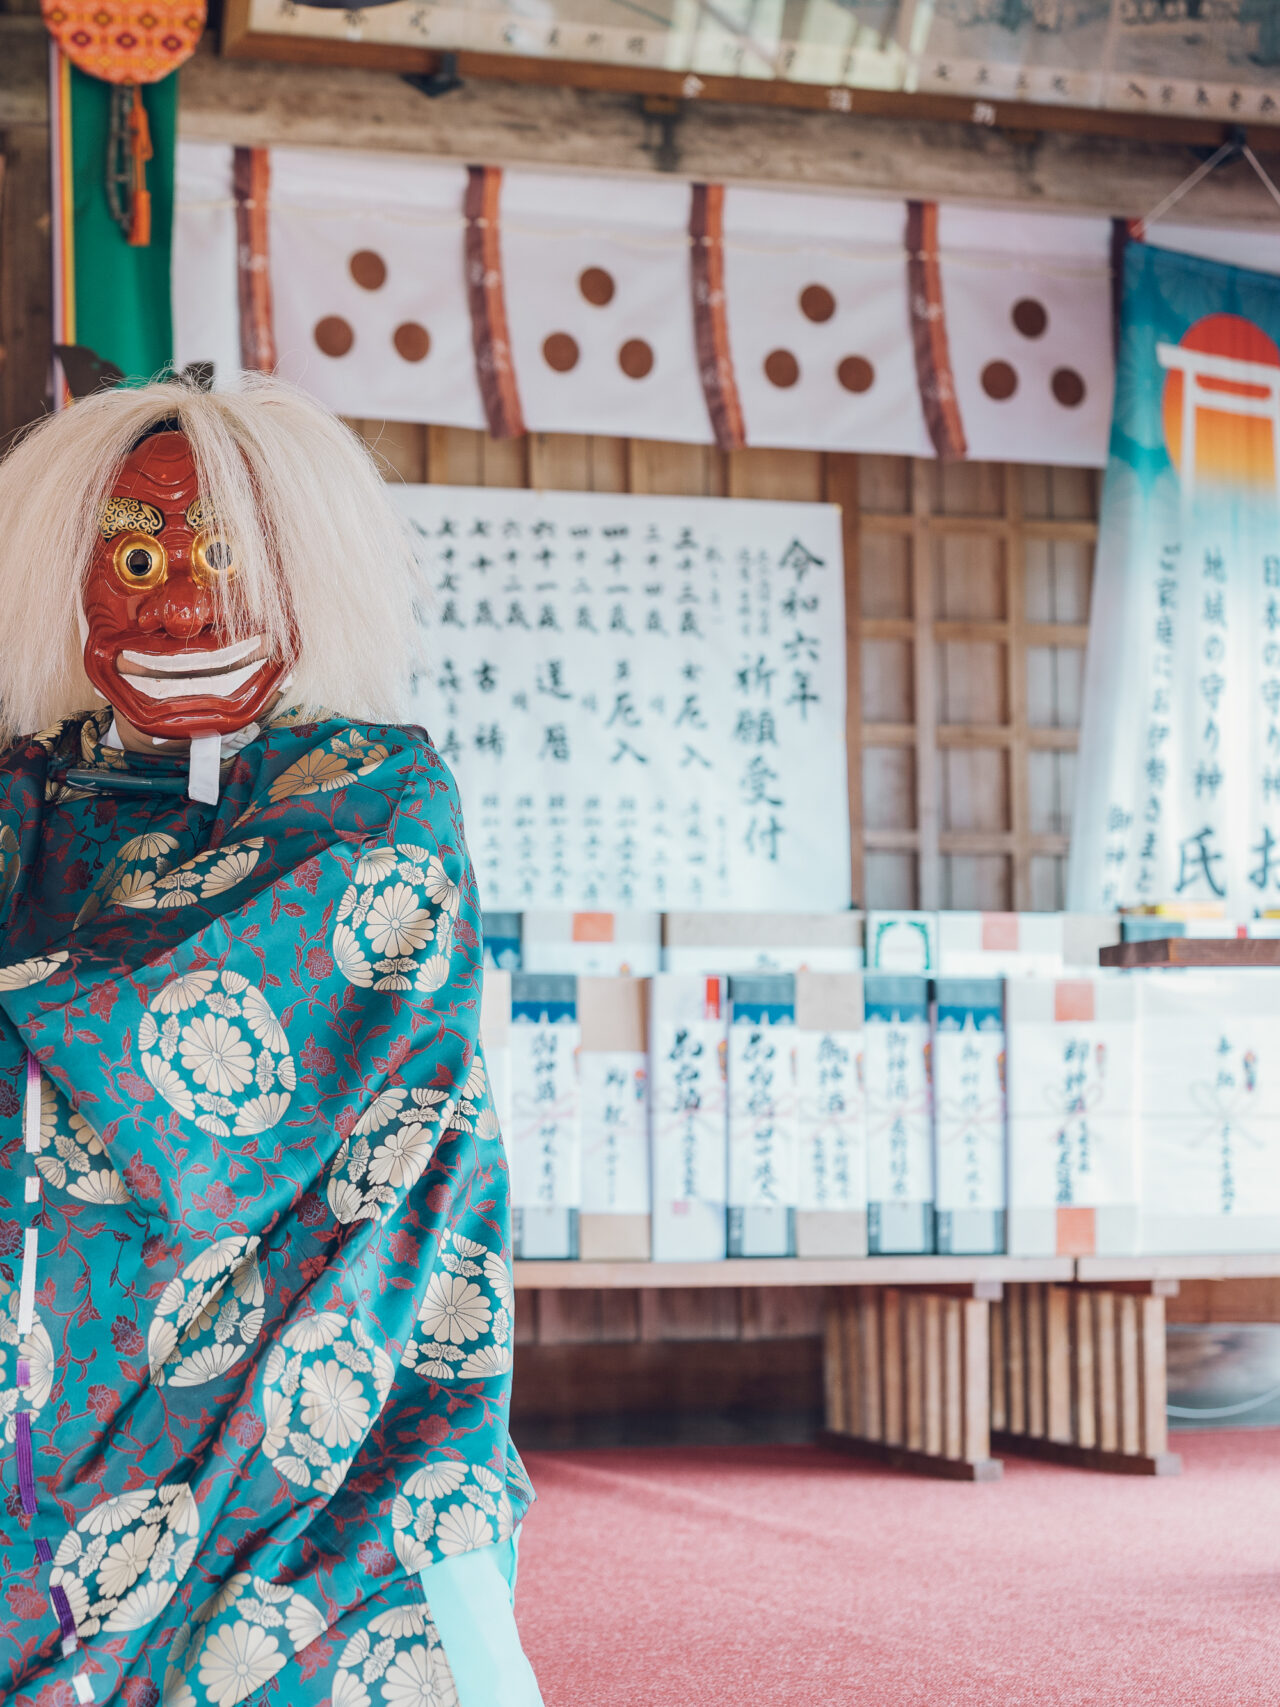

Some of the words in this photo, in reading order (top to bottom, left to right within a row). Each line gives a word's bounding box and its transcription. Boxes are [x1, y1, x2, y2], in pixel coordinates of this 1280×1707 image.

[776, 537, 827, 720] 令和六年
[732, 649, 788, 863] 祈願受付
[1175, 825, 1227, 898] 氏
